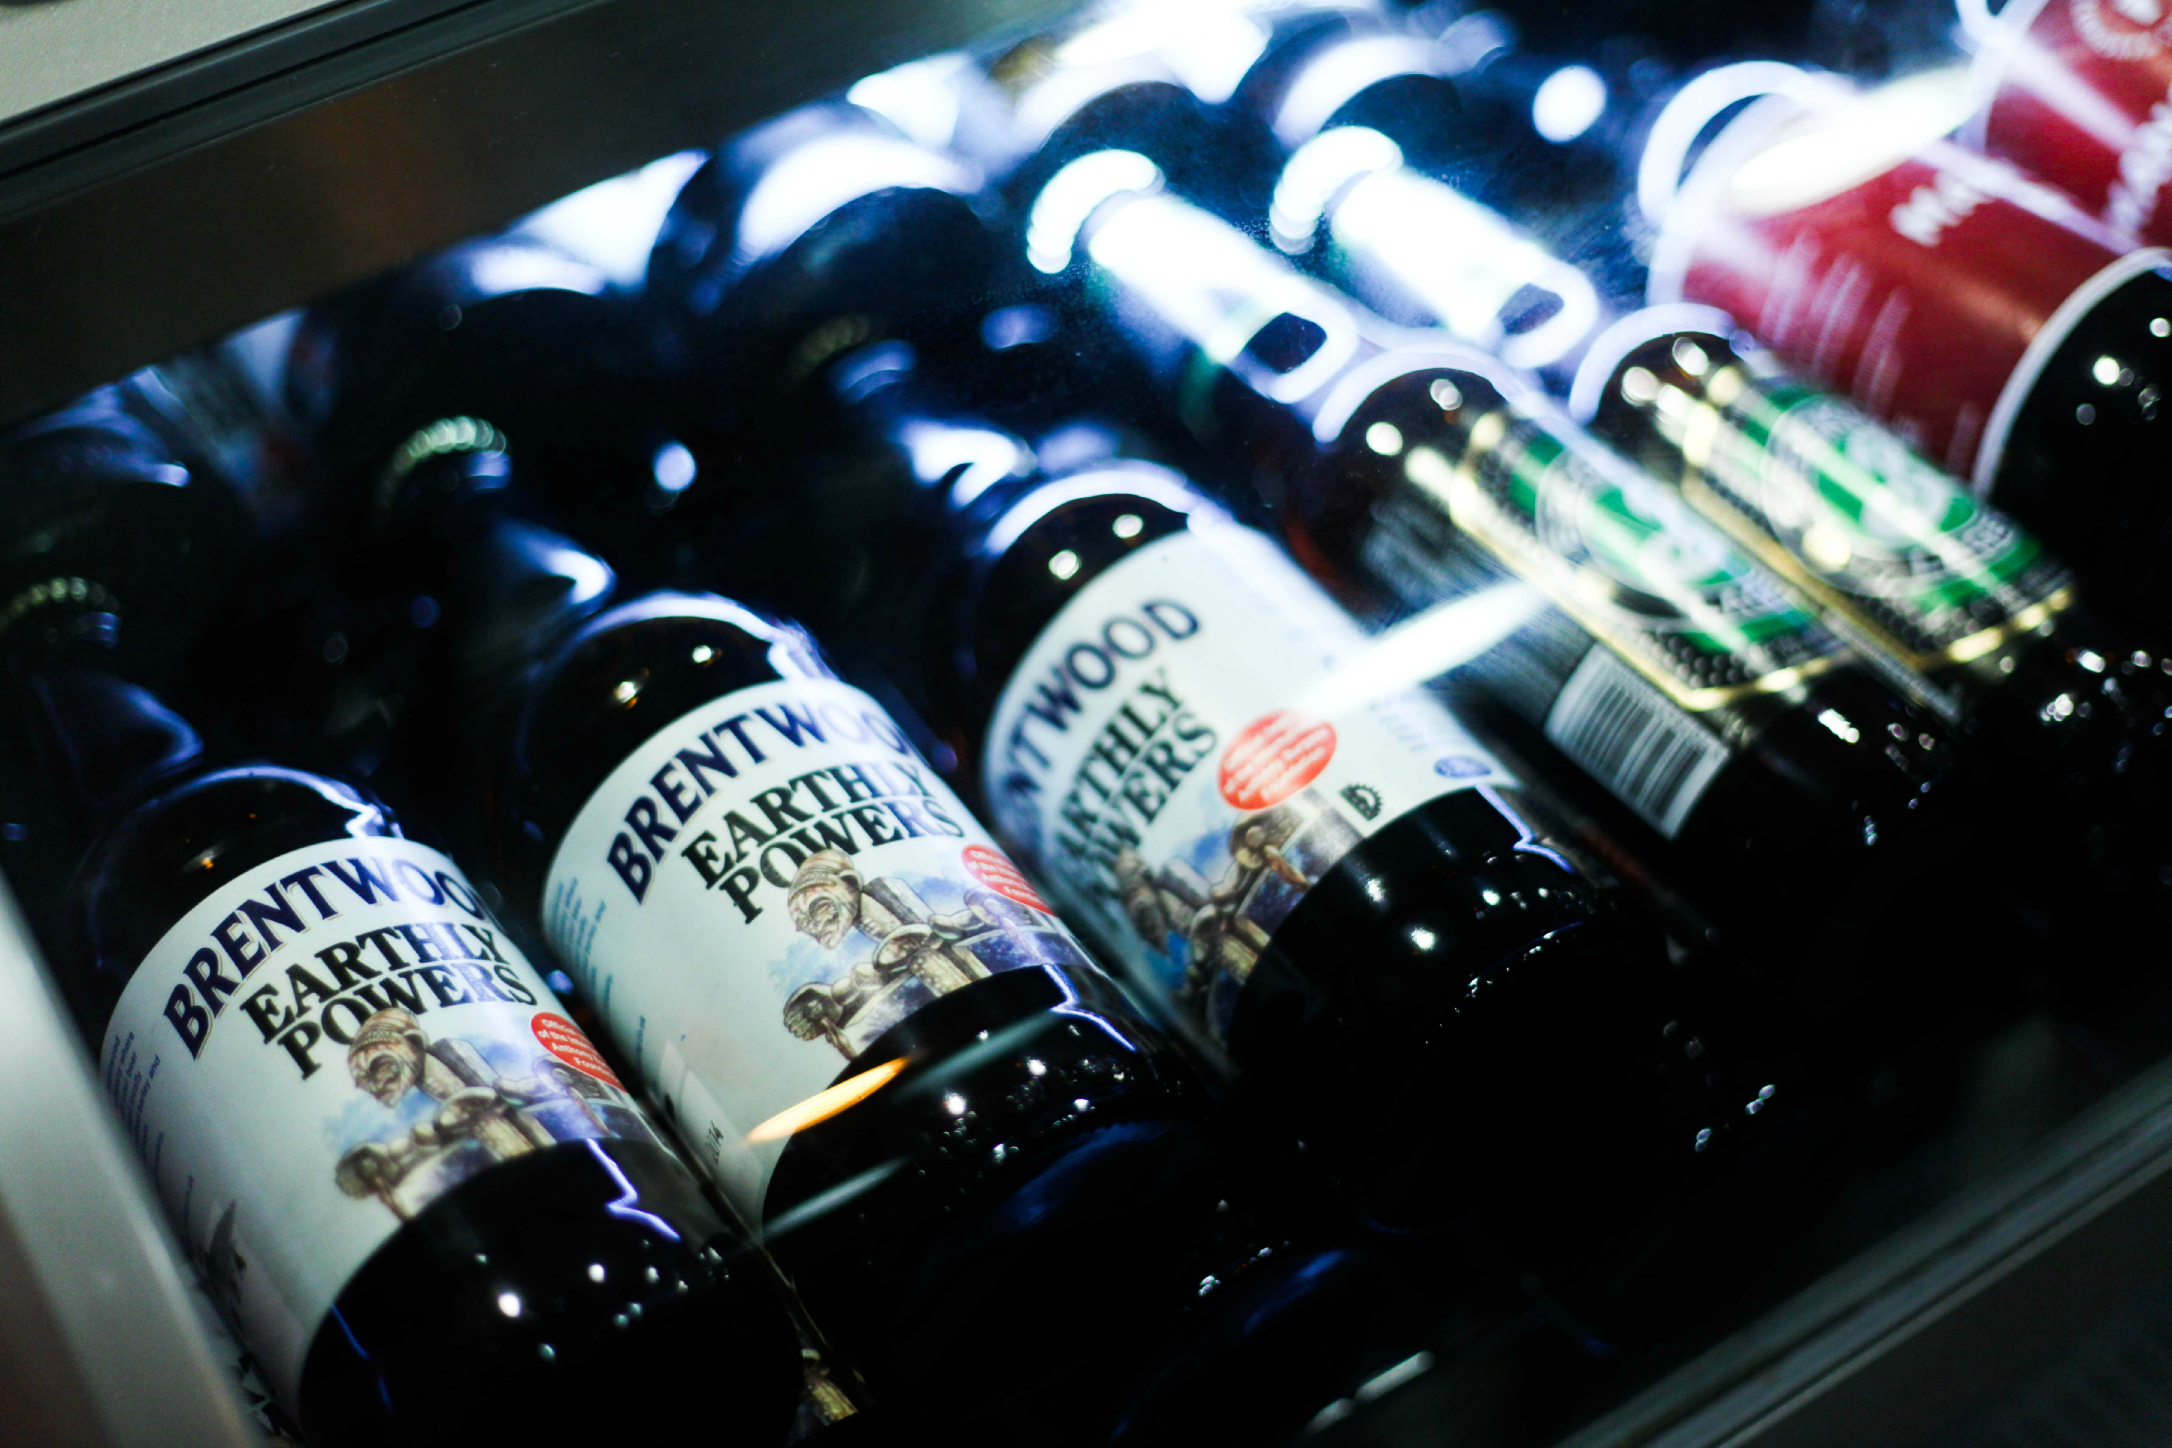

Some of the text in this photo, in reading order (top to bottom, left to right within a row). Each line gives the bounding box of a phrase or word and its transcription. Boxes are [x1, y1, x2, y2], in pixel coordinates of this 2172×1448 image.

[607, 700, 918, 906] BRENTWOO
[680, 760, 938, 890] EARTHLY
[719, 798, 966, 925] POWERS
[163, 857, 498, 1062] BRENTWOO
[239, 922, 512, 1045] EARTHLY
[277, 962, 539, 1081] POWERS
[149, 1054, 161, 1079] and
